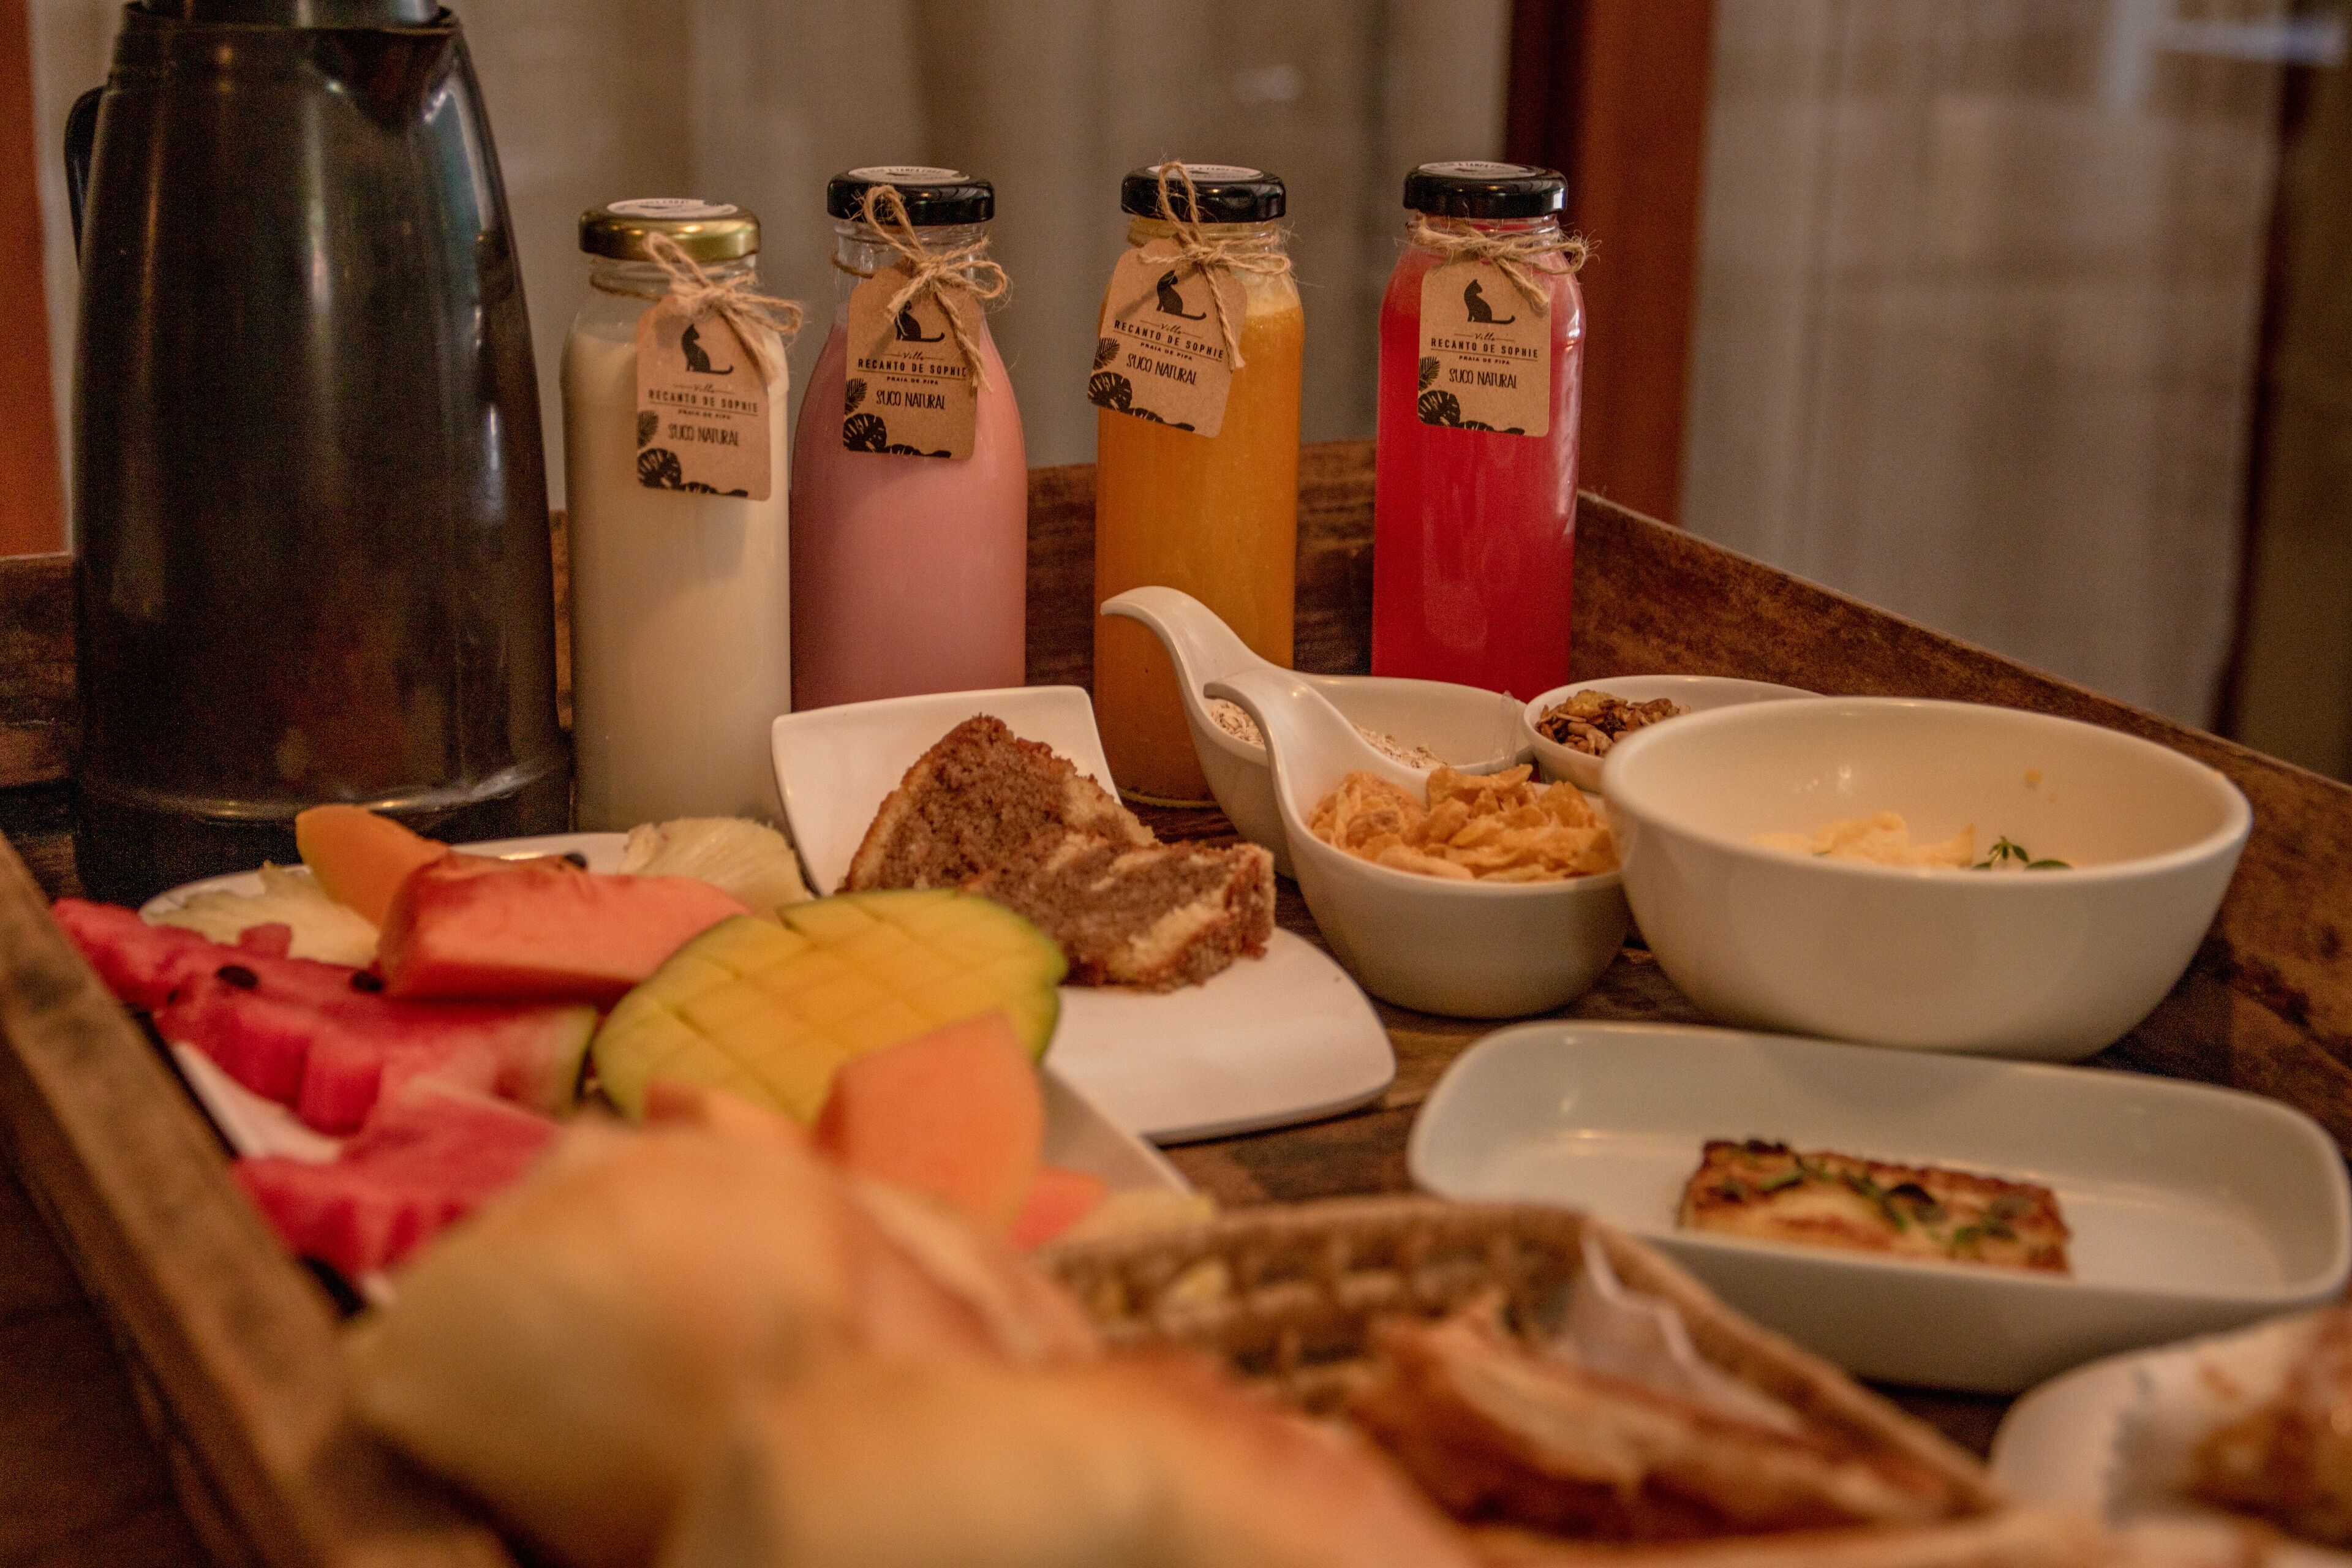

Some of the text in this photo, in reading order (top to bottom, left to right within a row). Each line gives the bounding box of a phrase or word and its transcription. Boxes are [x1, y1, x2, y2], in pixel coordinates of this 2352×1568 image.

[1114, 320, 1224, 359] RECANTO DE SOPHIE
[1431, 337, 1538, 358] RECANTO DE SOPHIE
[1140, 342, 1162, 352] PRAIA
[1177, 352, 1192, 360] PIPA
[858, 358, 967, 377] RECANTO DE SOPHIE
[1126, 353, 1197, 385] SUCO NATURAL
[1449, 368, 1518, 389] SUCO NATURAL
[649, 390, 758, 413] RECANTO DE SOPHIE
[876, 390, 945, 410] SUCO NATURAL
[668, 423, 739, 447] SUCO NATURAL
